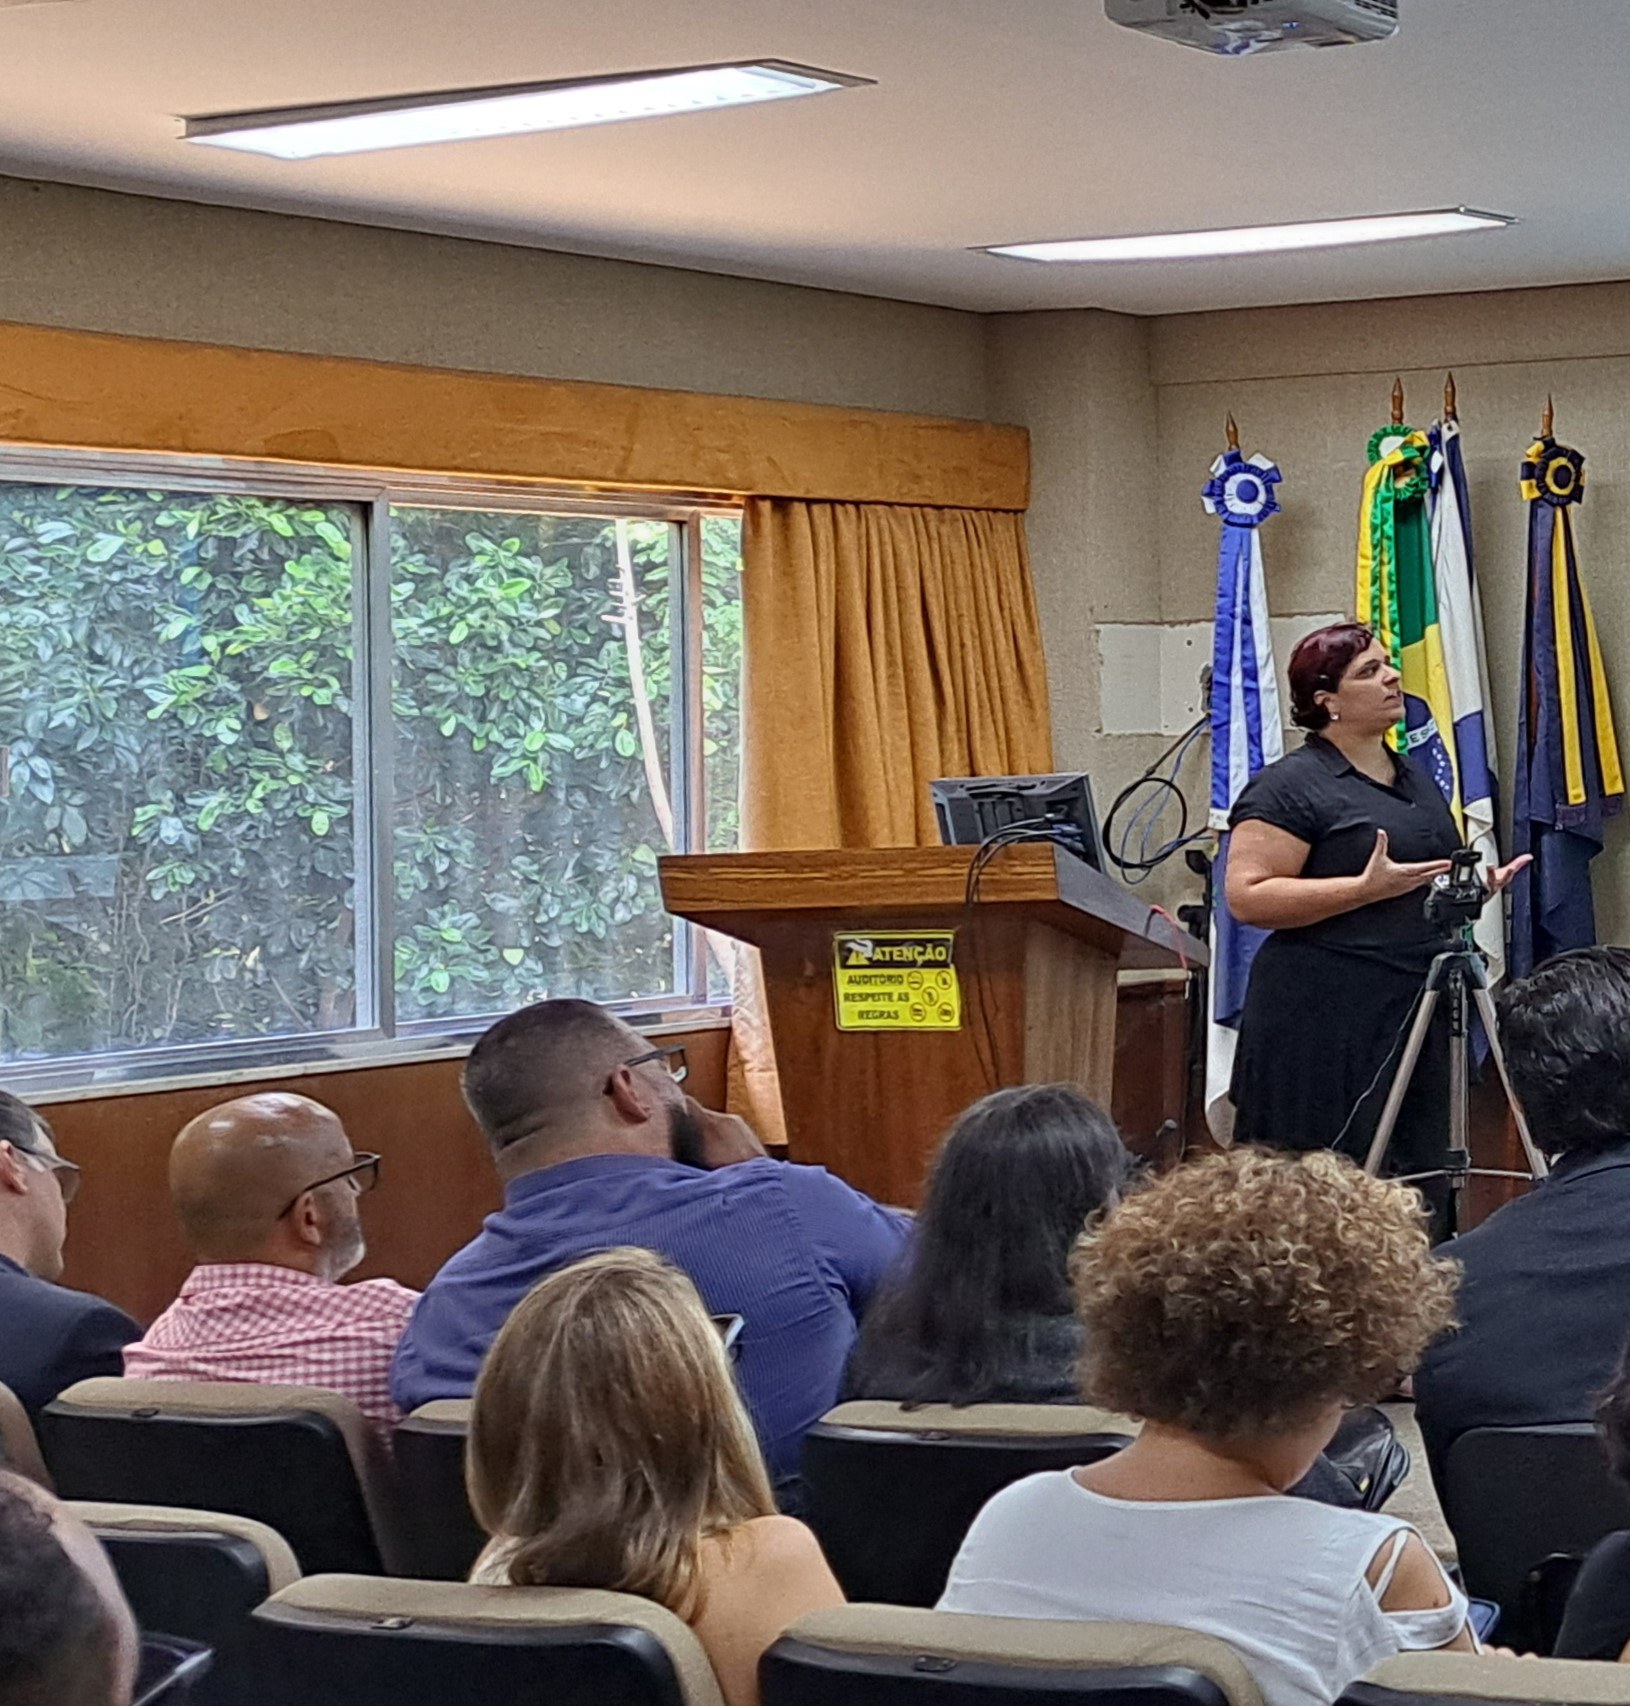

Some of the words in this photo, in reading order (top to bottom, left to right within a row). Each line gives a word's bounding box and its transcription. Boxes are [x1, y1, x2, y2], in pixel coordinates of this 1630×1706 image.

[872, 943, 947, 966] ATENÇÃO
[843, 992, 894, 1003] RESPEITE
[897, 992, 910, 1003] AS
[857, 1010, 899, 1020] REGRAS
